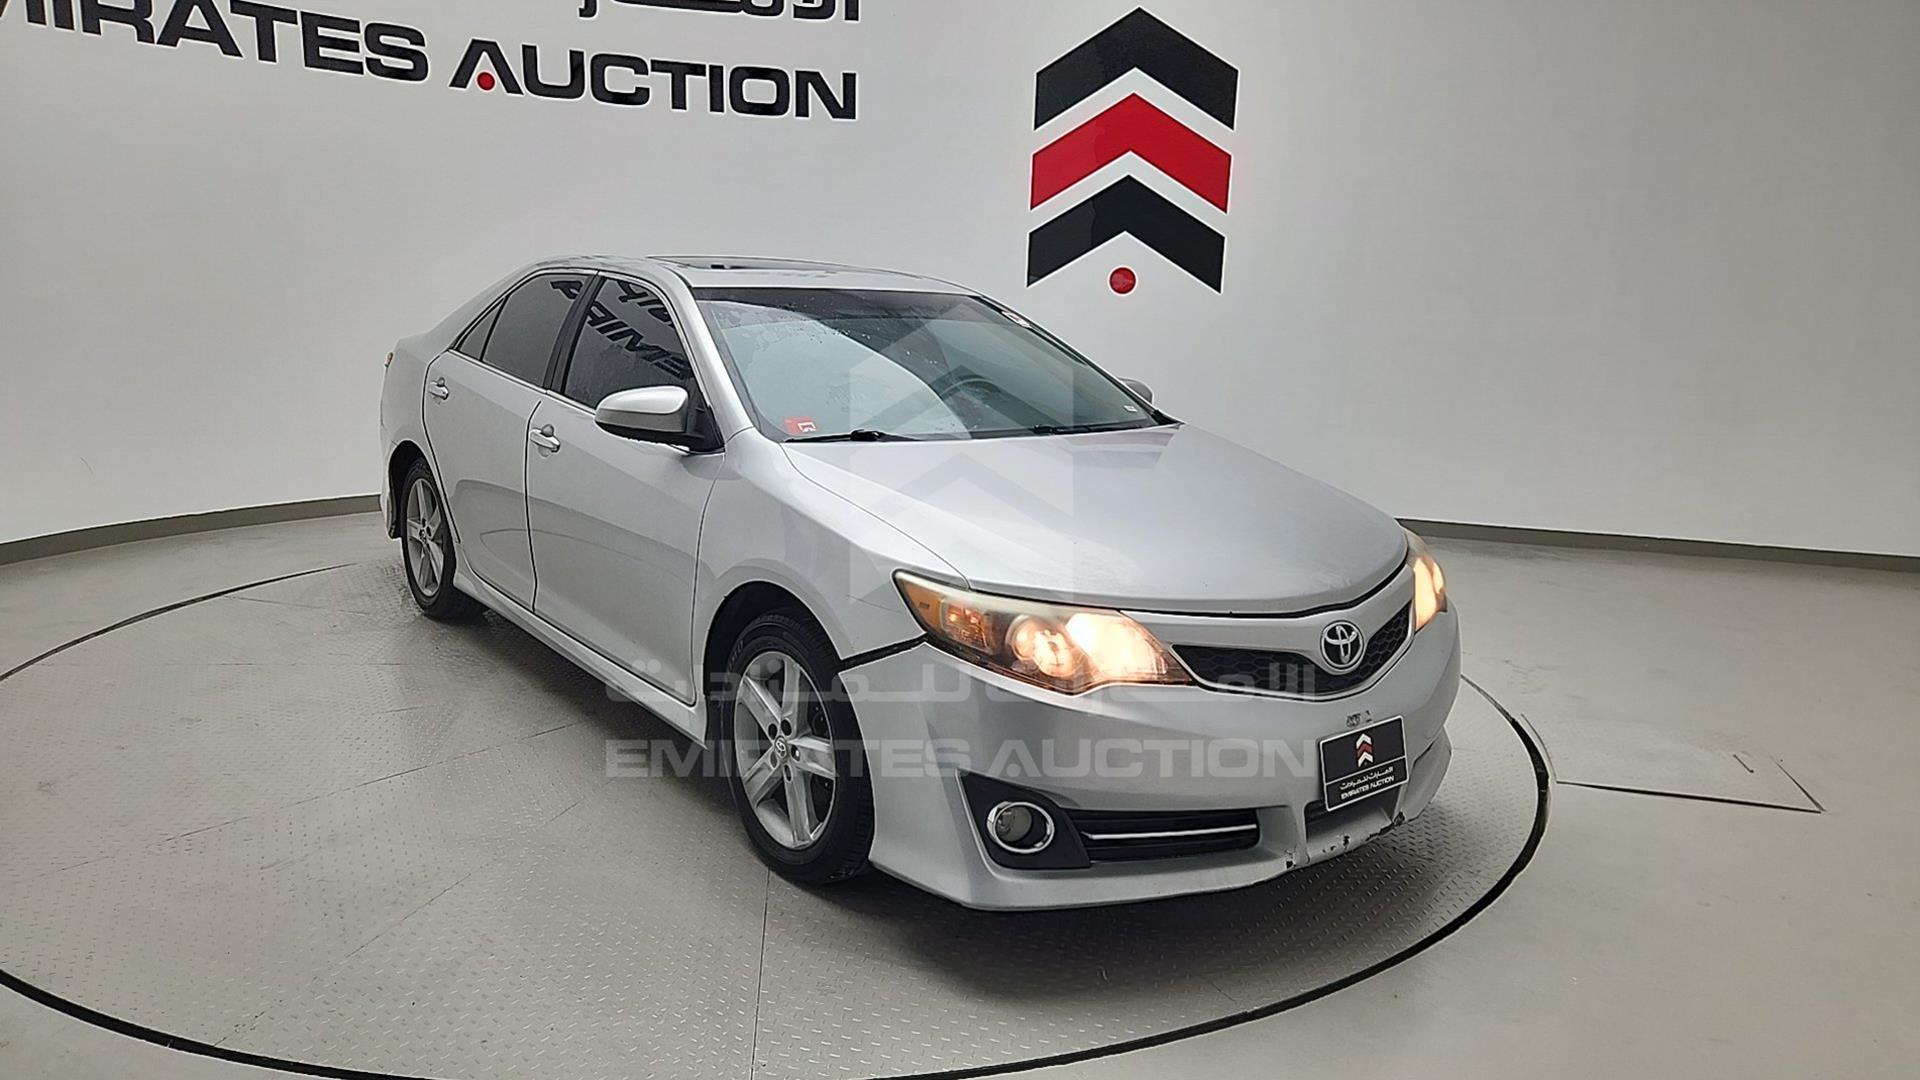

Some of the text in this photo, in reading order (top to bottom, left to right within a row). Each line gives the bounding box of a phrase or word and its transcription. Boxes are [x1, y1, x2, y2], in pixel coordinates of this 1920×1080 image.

[449, 38, 858, 119] AUCTION
[1341, 775, 1395, 799] EMIRATES AUCTION
